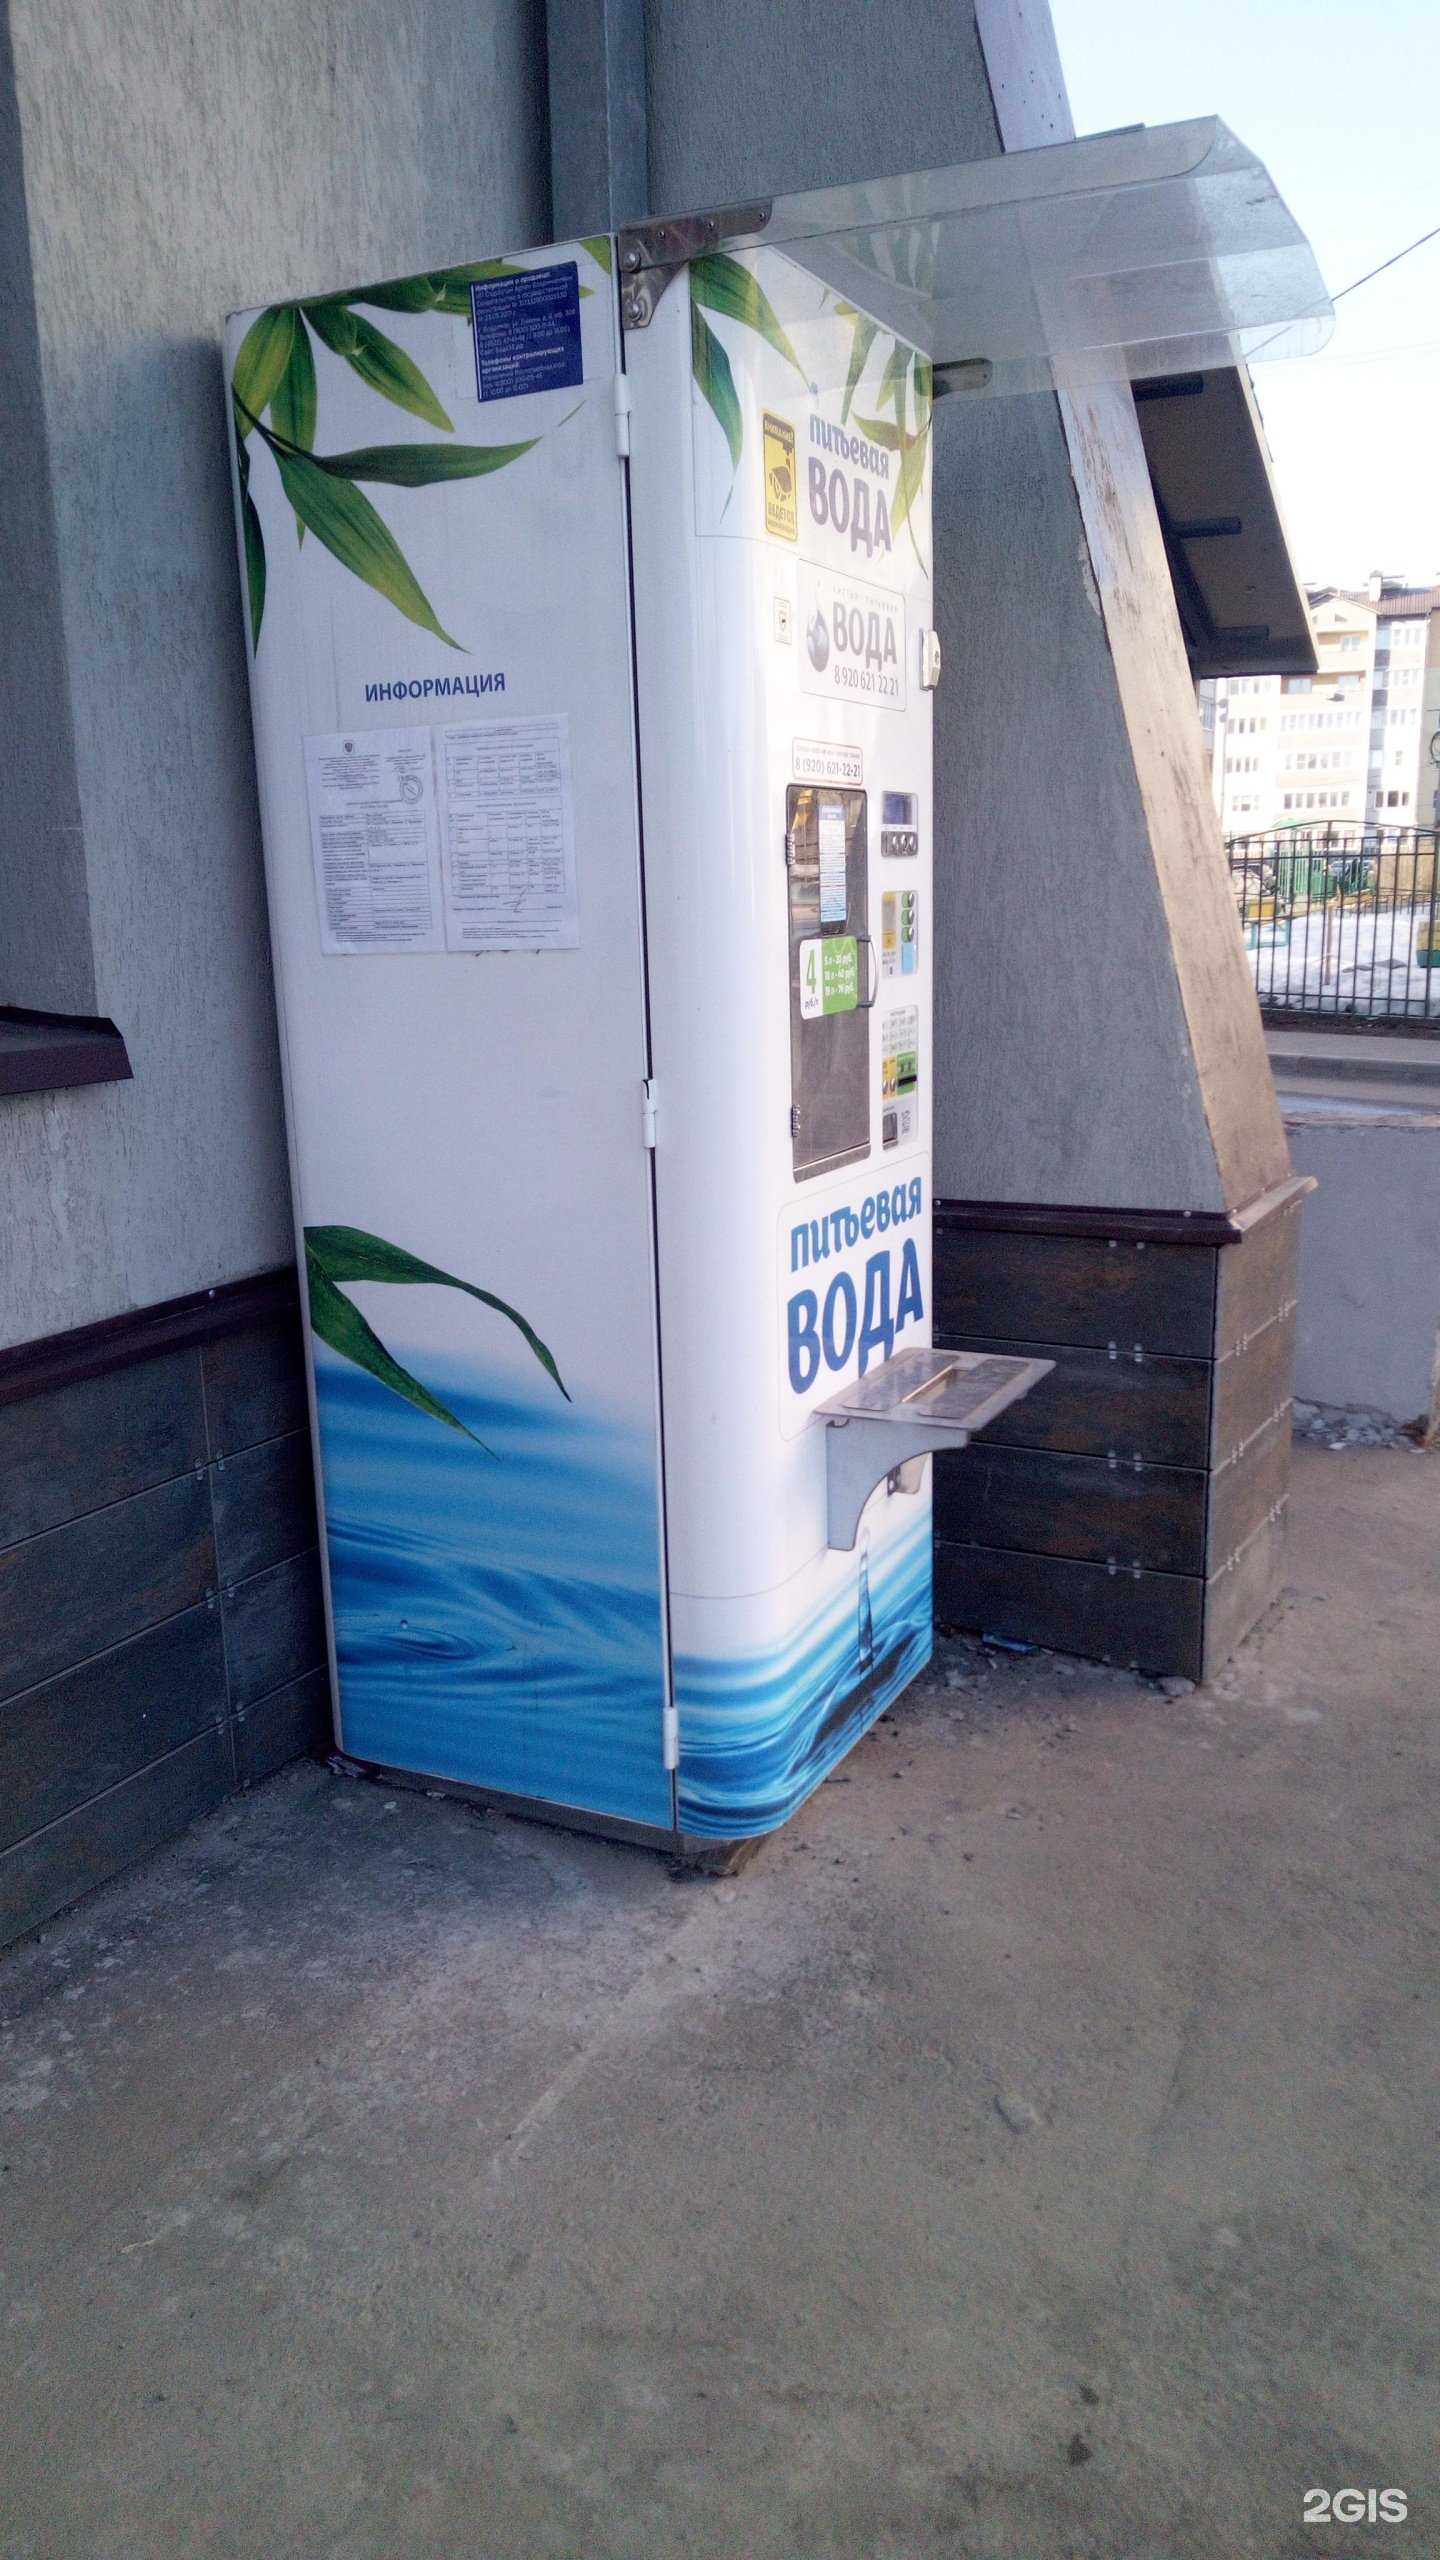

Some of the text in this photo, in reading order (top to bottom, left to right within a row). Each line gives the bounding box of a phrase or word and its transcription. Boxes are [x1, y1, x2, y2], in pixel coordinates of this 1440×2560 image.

[810, 414, 889, 480] питьевая
[808, 456, 892, 558] ВОДА
[833, 601, 898, 672] ВОДА
[365, 672, 506, 703] ИНФОРМАЦИЯ
[834, 665, 841, 685] 8
[842, 667, 859, 688] 920
[860, 671, 875, 692] 621
[890, 677, 899, 696] 21
[806, 948, 817, 994] 4
[790, 1176, 922, 1273] питьевая
[787, 1238, 924, 1395] ВОДА
